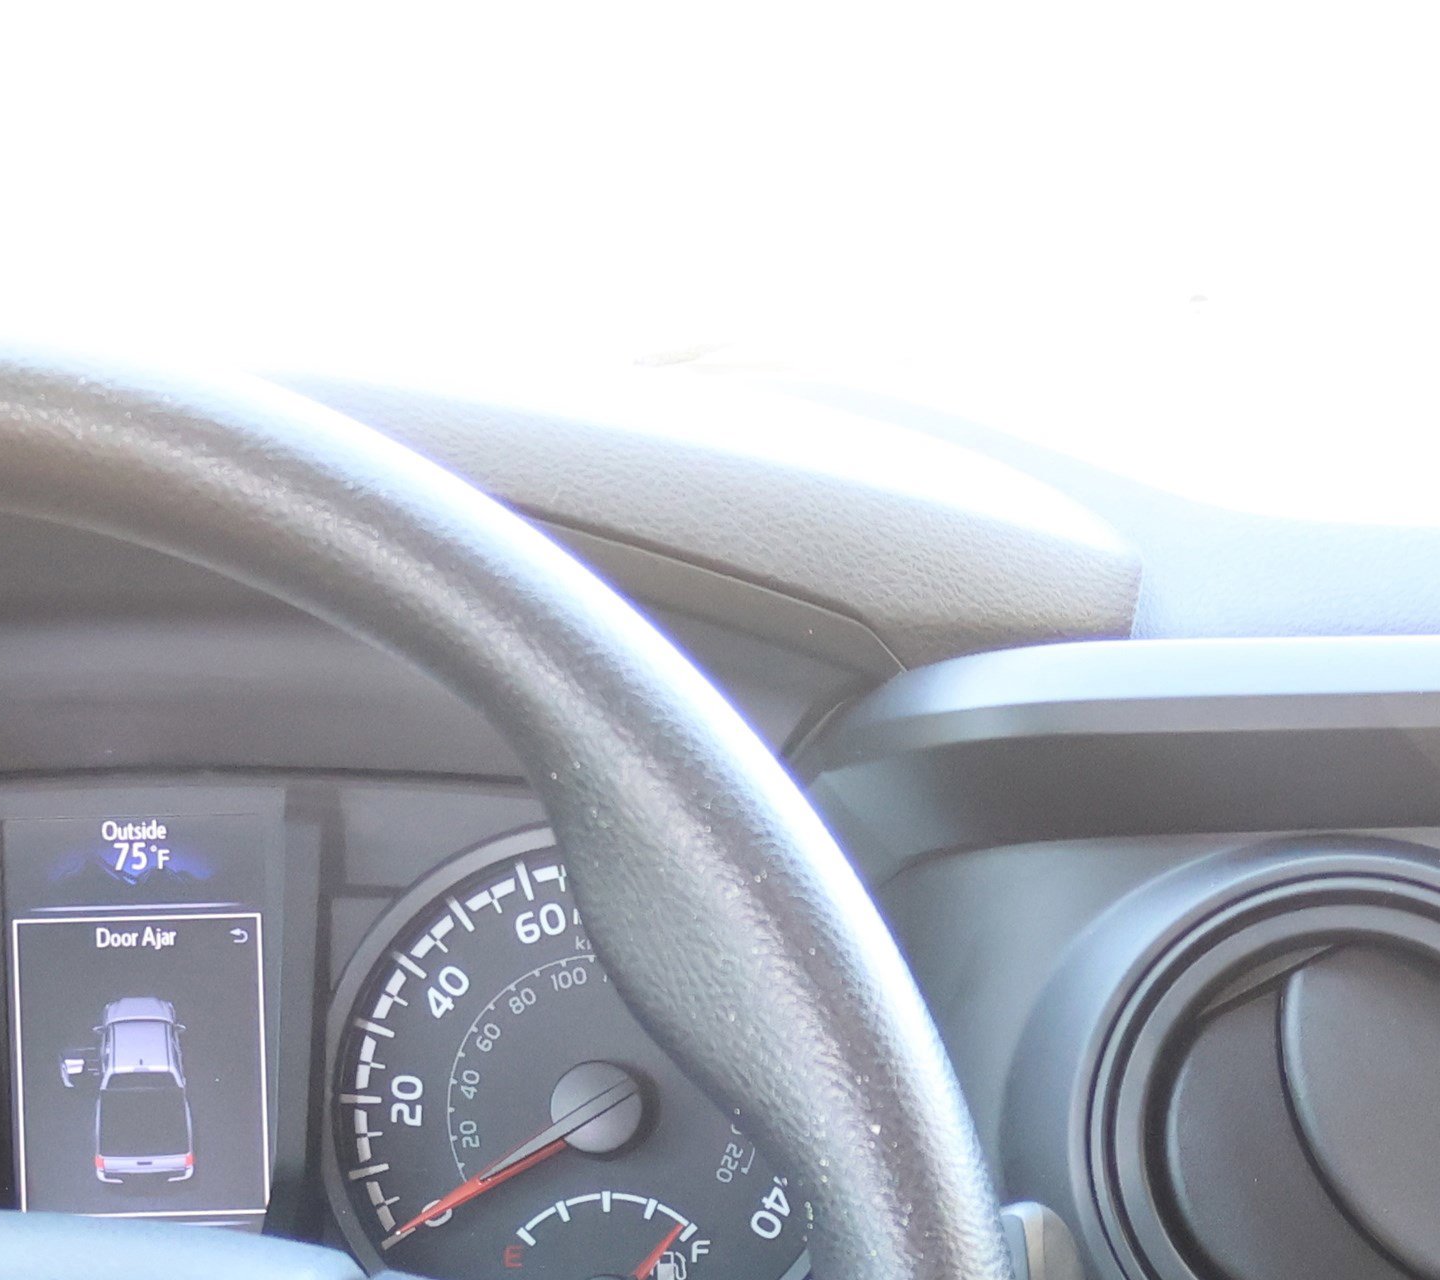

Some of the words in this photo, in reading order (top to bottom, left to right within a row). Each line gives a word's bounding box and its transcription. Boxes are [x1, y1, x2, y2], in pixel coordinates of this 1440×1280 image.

[102, 819, 167, 840] Outside
[514, 903, 566, 944] 60
[96, 927, 138, 947] Door
[141, 926, 177, 950] Ajar
[427, 965, 470, 1018] 40
[549, 967, 588, 992] 100
[508, 988, 537, 1016] 80
[476, 1024, 501, 1053] 60
[462, 1069, 481, 1100] 40
[391, 1075, 423, 1127] 20
[461, 1120, 481, 1149] 20
[503, 1245, 523, 1268] E
[691, 1239, 710, 1263] F
